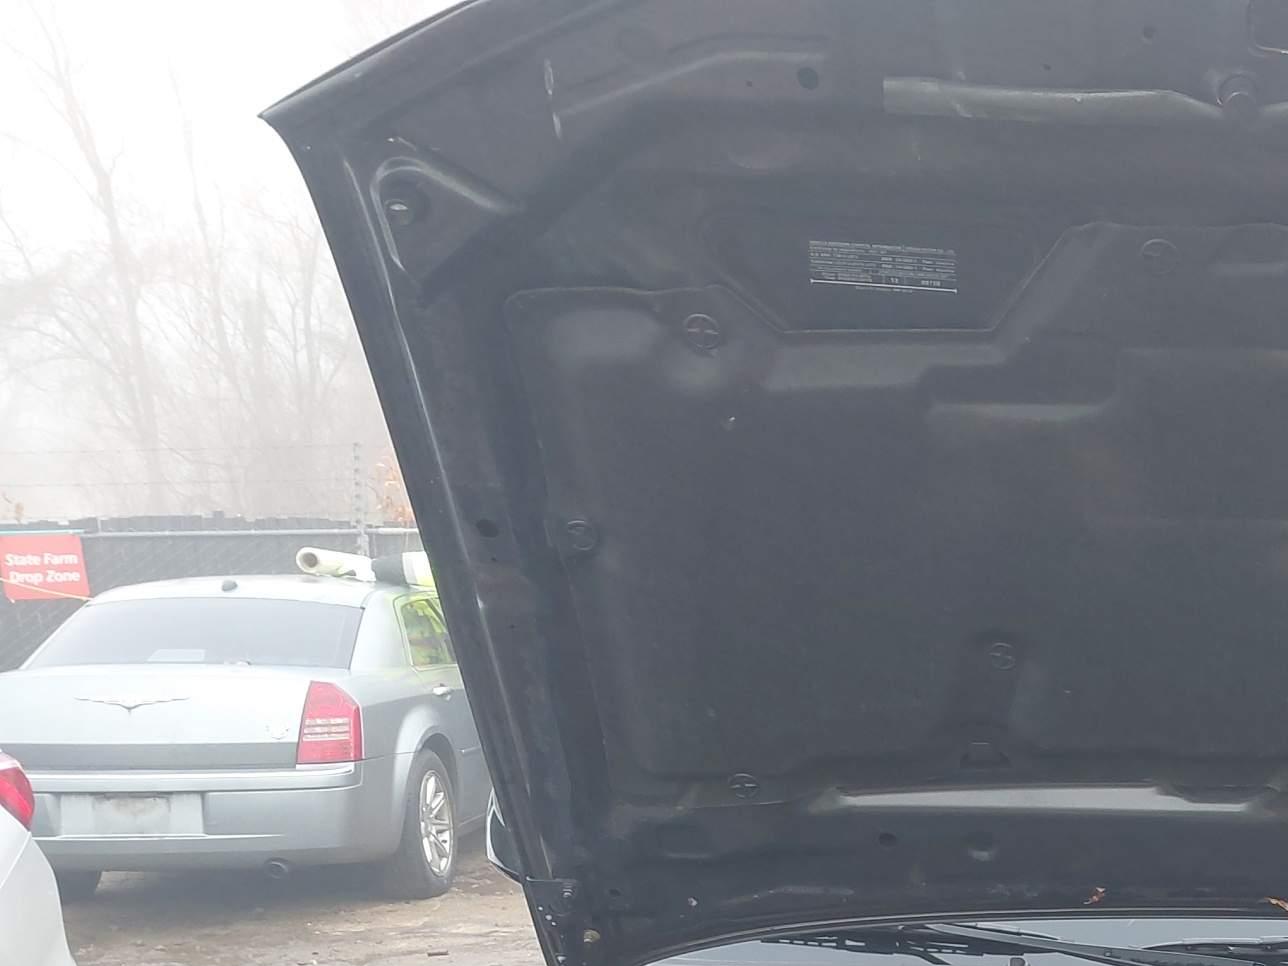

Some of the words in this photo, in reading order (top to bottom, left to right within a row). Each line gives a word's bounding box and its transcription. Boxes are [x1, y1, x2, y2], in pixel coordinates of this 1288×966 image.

[4, 552, 41, 566] State
[43, 552, 78, 565] Farm
[9, 571, 43, 585] Drop
[45, 569, 81, 582] Zone
